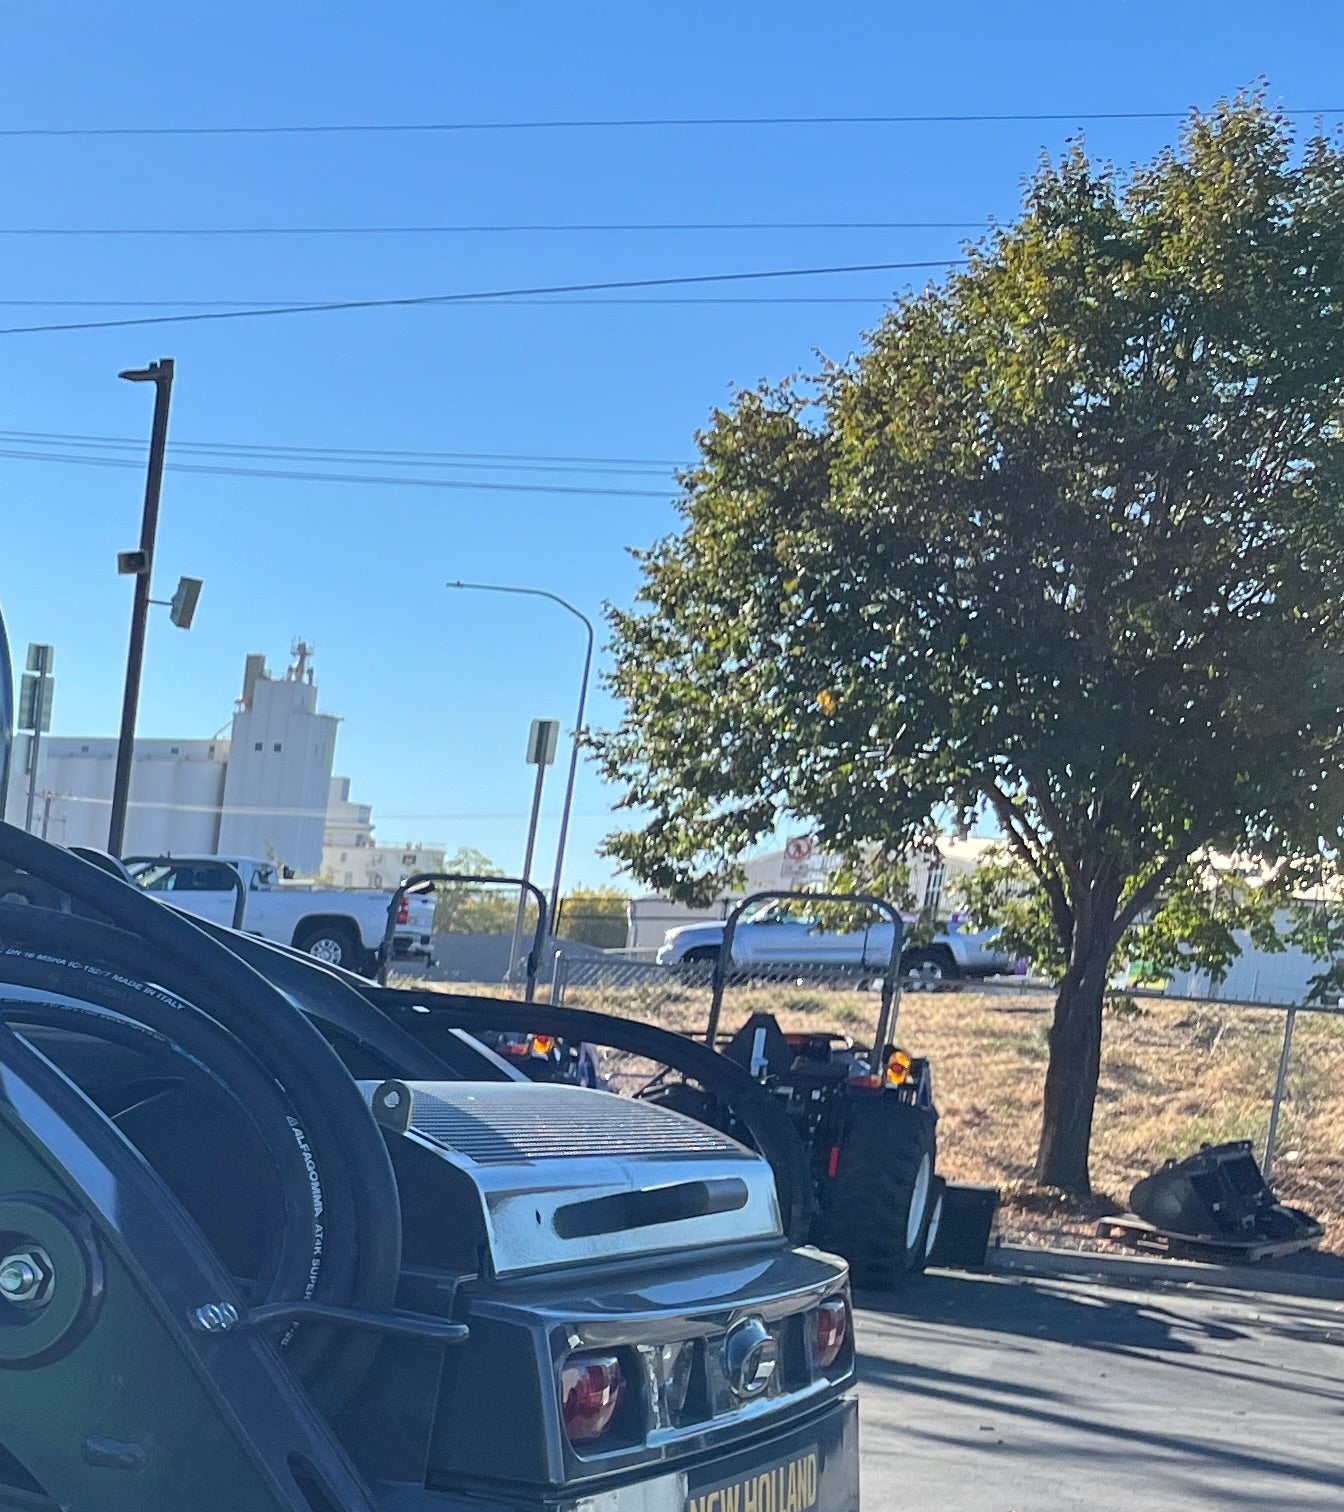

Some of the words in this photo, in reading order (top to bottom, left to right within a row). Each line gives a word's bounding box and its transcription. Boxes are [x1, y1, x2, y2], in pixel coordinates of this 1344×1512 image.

[111, 974, 142, 991] MADE
[143, 986, 156, 996] IN
[156, 989, 185, 1011] ITALY
[292, 1127, 324, 1218] ALFAGOMMA
[313, 1223, 324, 1256] AT4K
